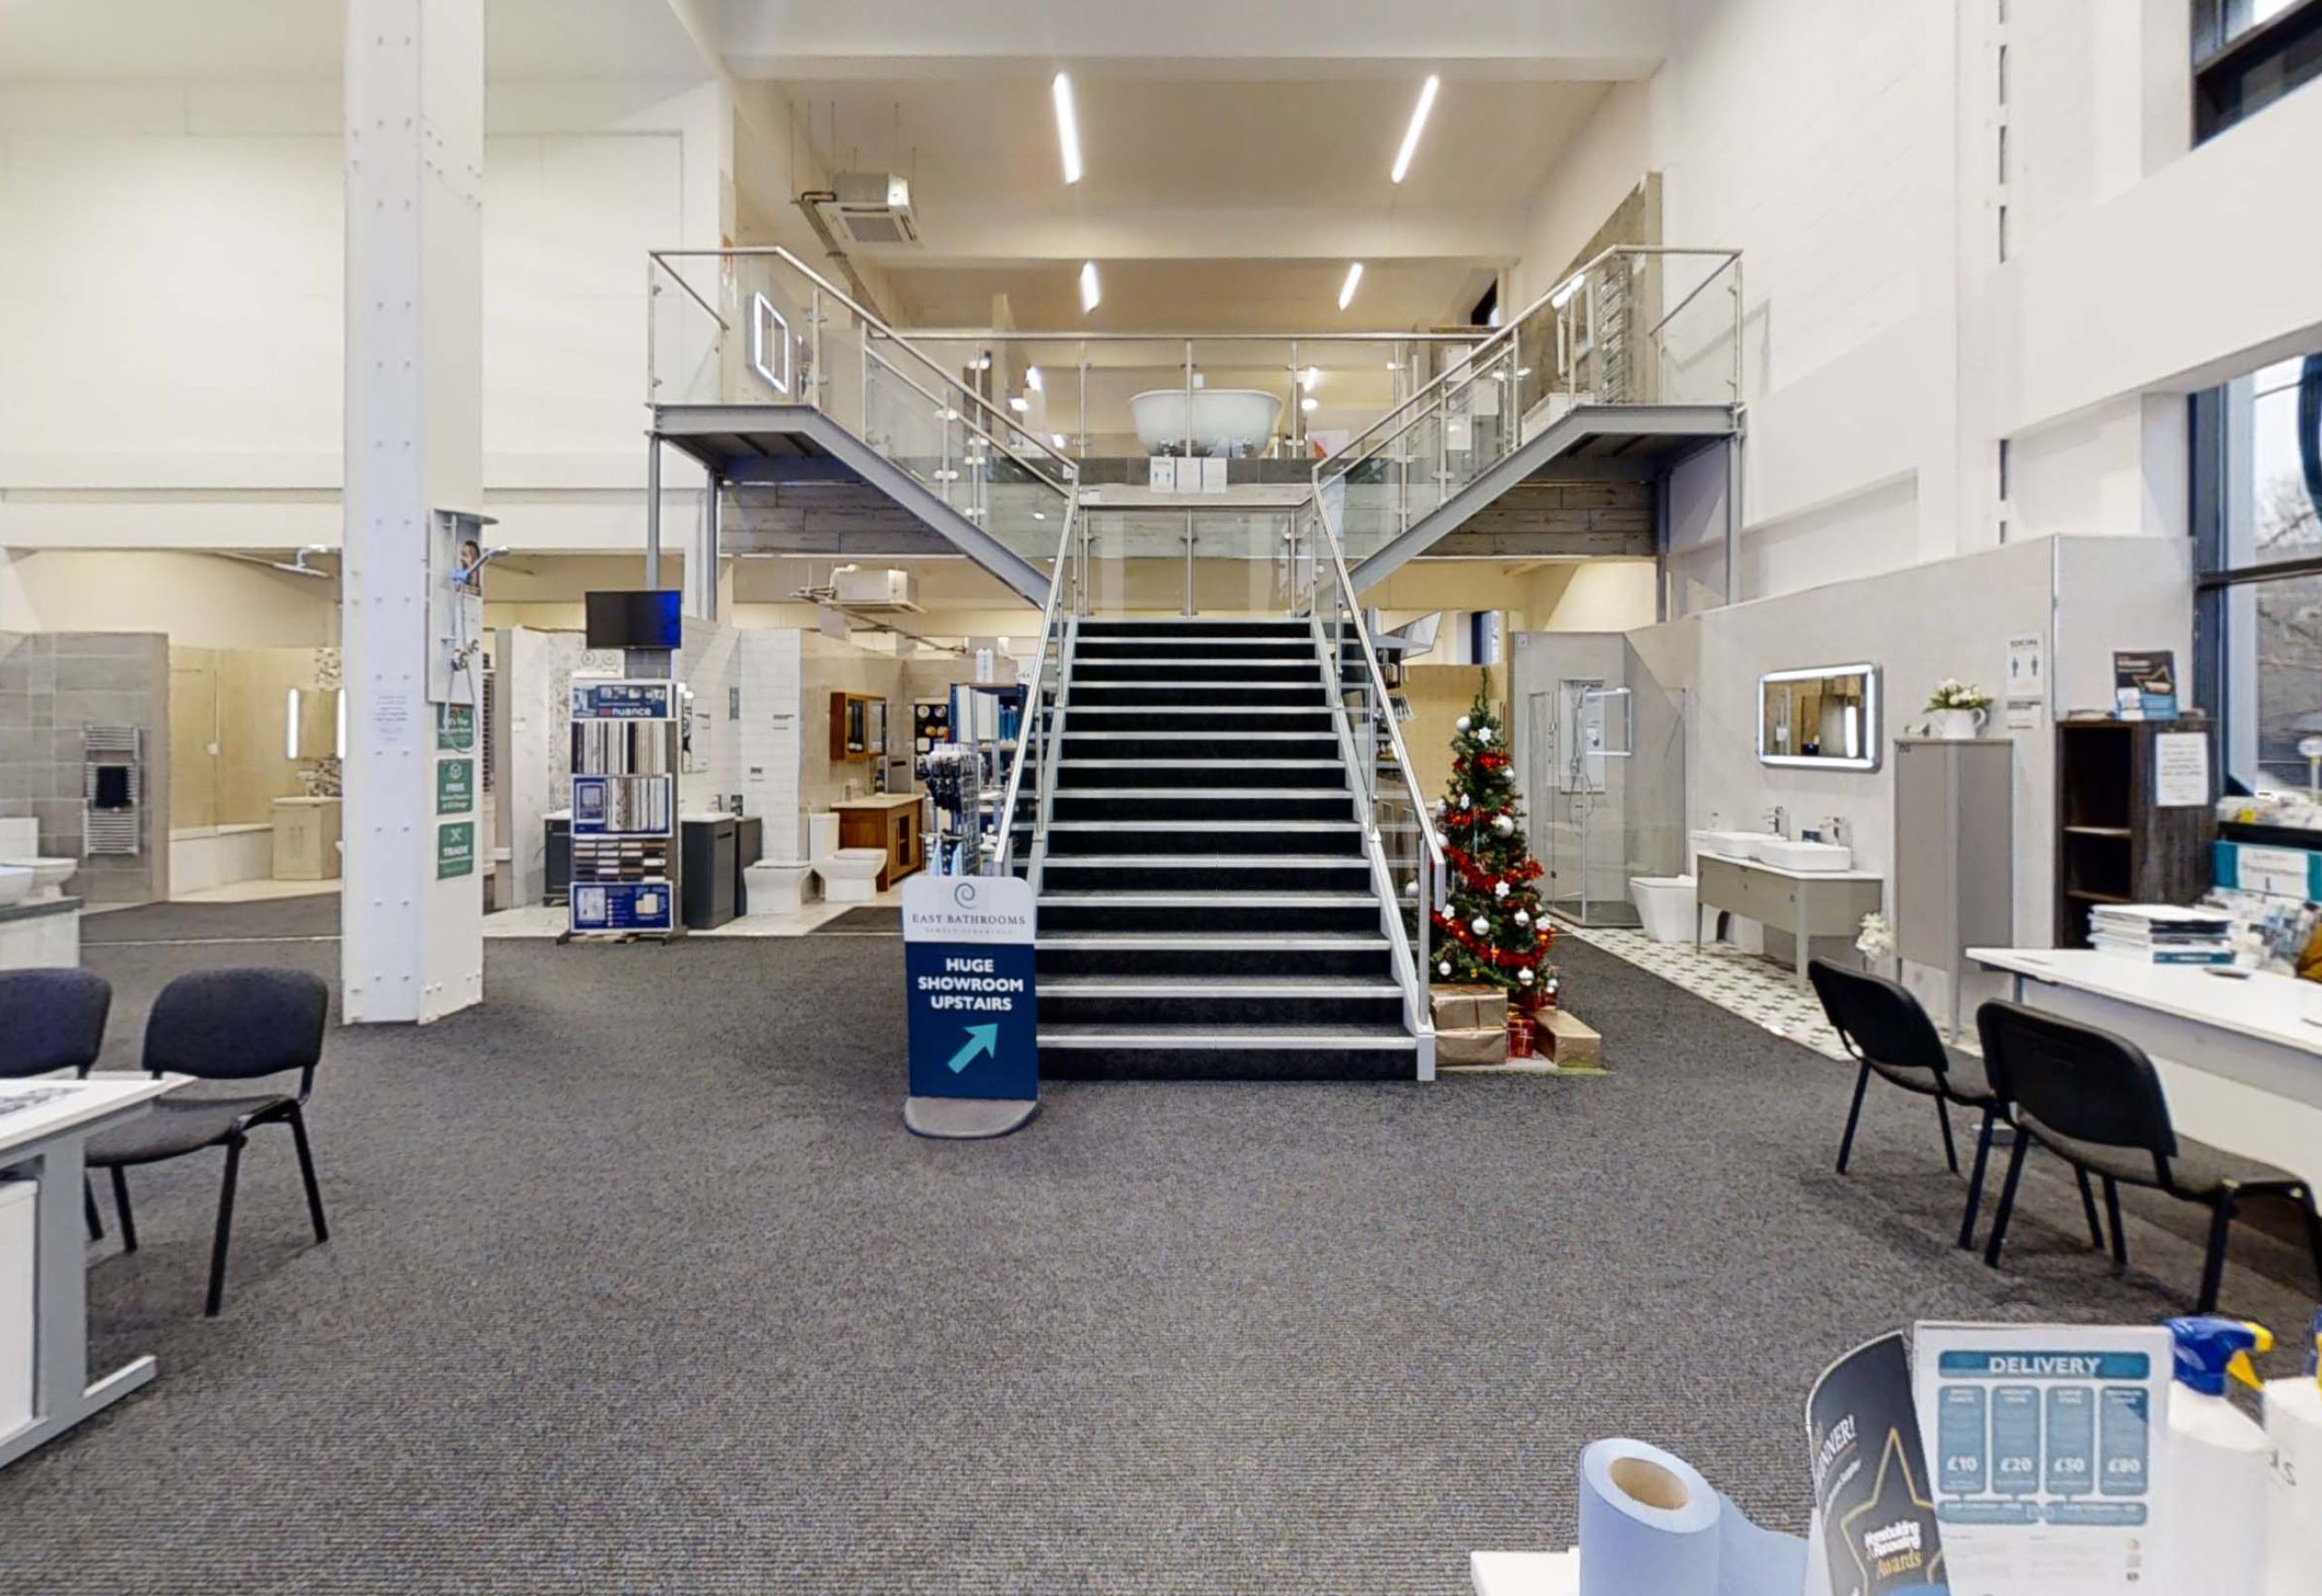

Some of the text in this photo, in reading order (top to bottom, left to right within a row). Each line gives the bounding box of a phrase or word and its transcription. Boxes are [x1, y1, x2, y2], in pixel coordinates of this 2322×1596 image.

[912, 913, 1026, 925] EASY BATHROOMS
[945, 958, 994, 973] HUGE
[918, 976, 1024, 993] SHOWROOM
[931, 996, 1012, 1011] UPSTAIRS
[1989, 1357, 2102, 1375] DELIVERY
[1946, 1455, 1979, 1473] £10
[1999, 1456, 2034, 1473] £20
